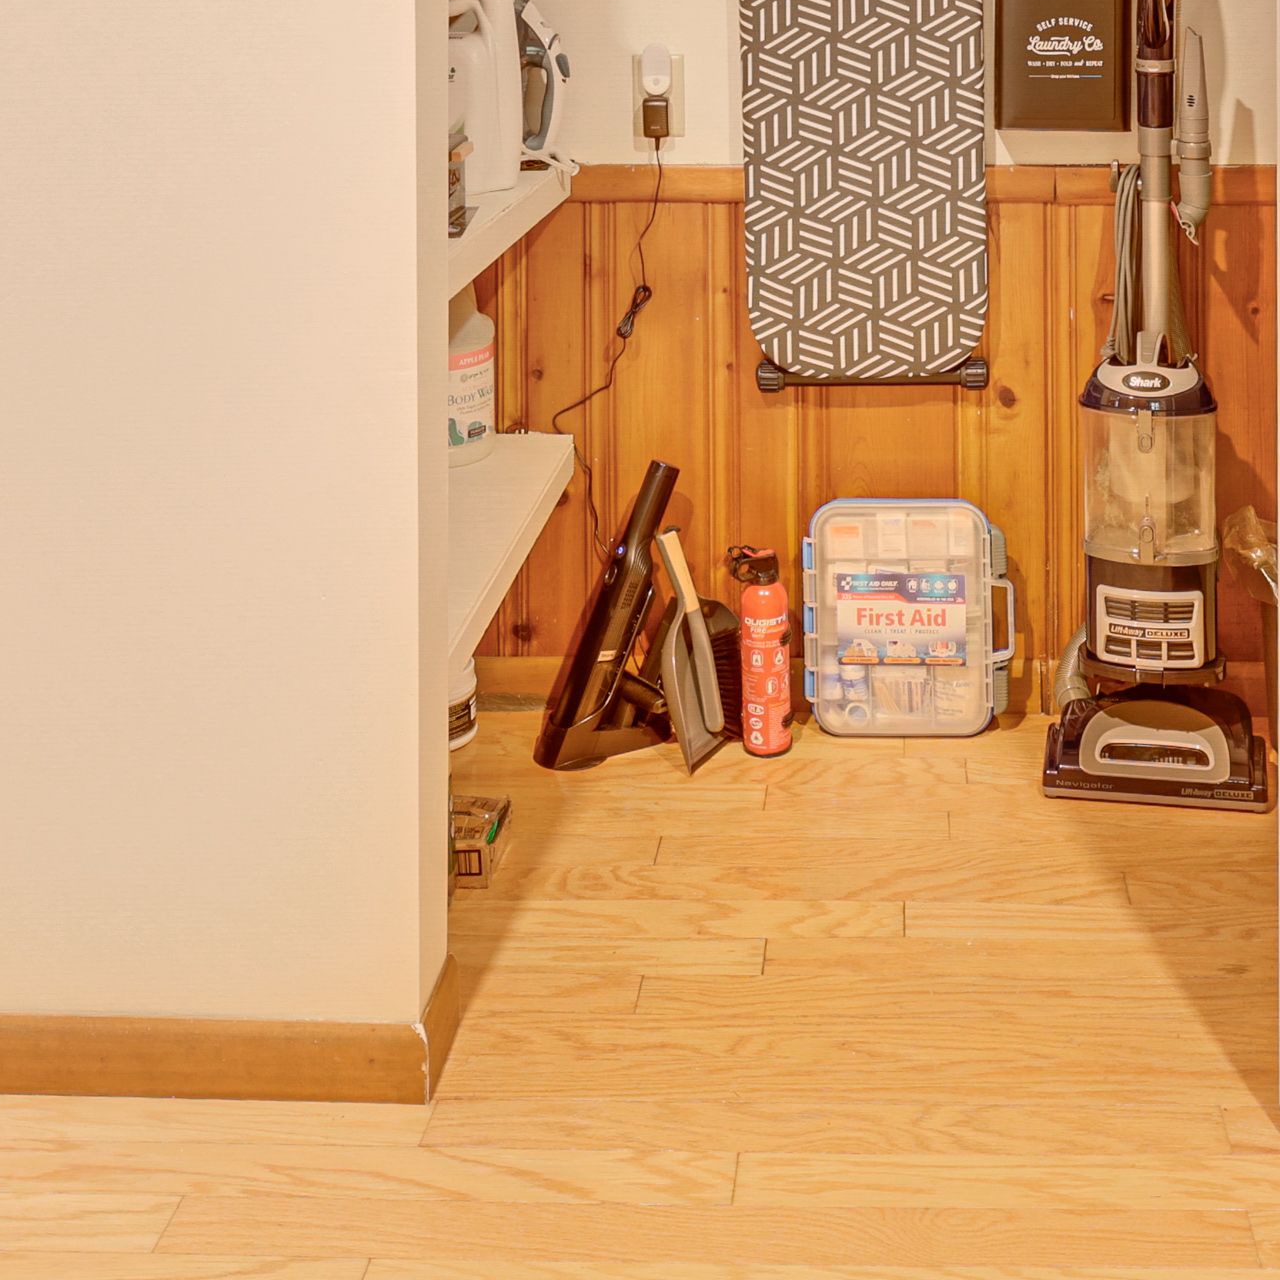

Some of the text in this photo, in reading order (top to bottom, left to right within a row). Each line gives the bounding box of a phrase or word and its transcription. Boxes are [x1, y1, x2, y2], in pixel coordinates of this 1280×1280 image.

[1036, 17, 1094, 32] SELF SERVICE
[1027, 35, 1083, 56] Laundry
[1129, 376, 1162, 388] Shark
[448, 392, 476, 406] BODY
[856, 607, 948, 628] First Aid
[1055, 779, 1115, 790] Navigator
